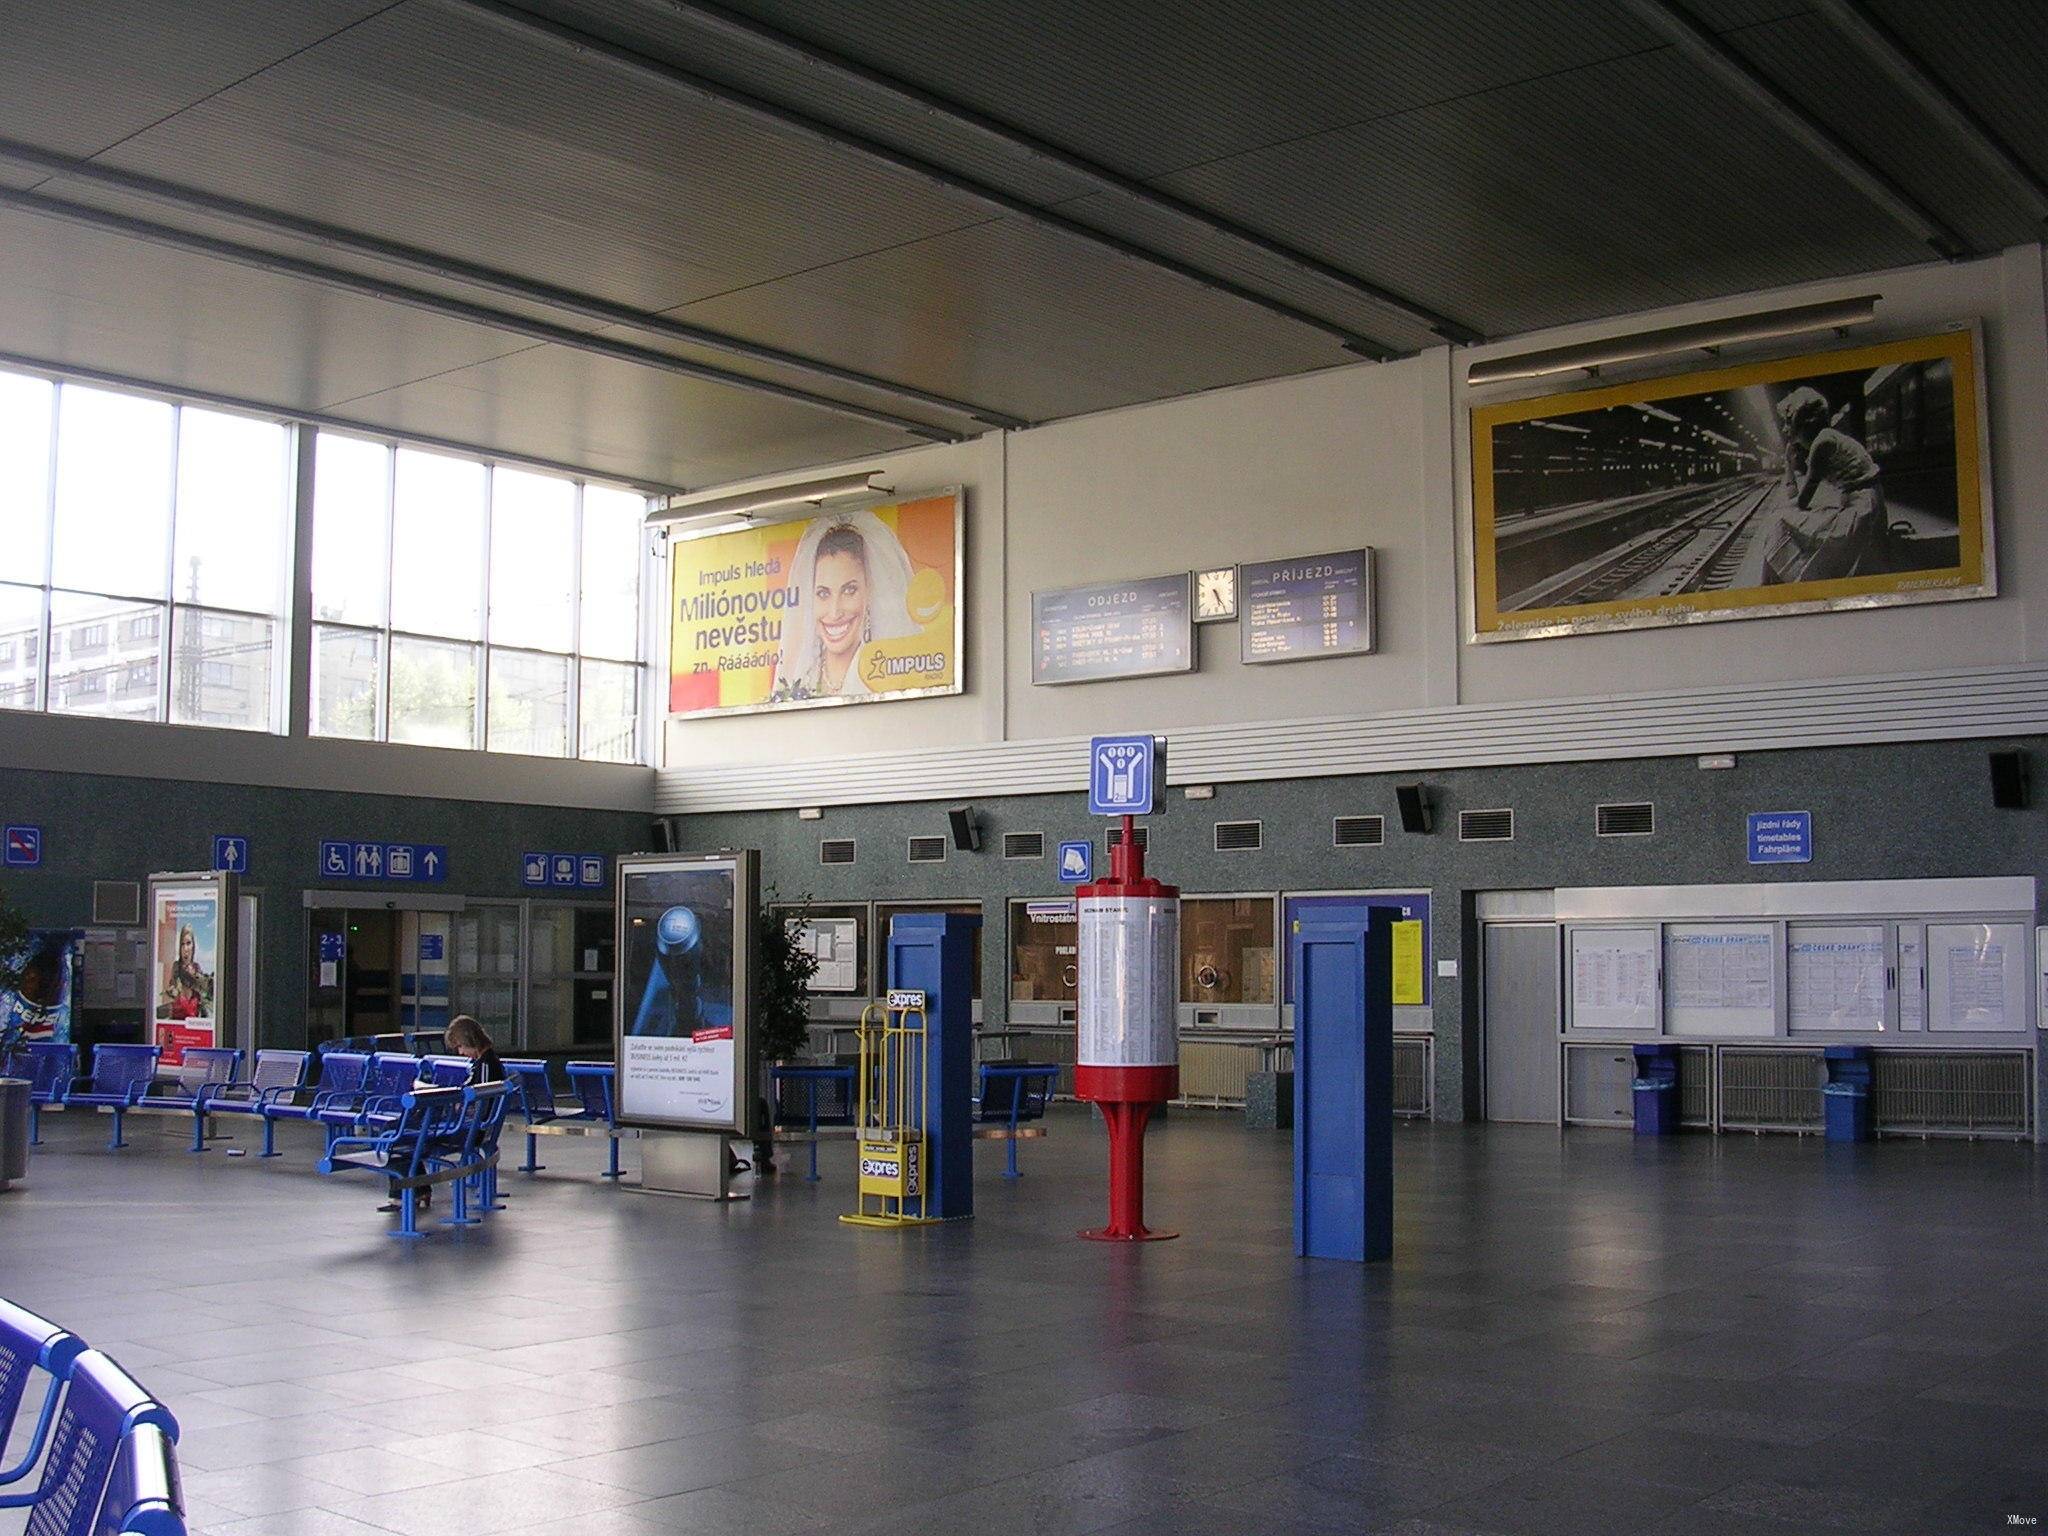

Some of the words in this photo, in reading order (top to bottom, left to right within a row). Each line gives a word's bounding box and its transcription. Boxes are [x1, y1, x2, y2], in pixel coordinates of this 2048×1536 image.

[699, 564, 741, 587] Impuls
[745, 557, 781, 578] hledá
[680, 585, 800, 623] Miliónovou
[1088, 591, 1138, 607] ODJEZD
[696, 615, 782, 651] nevěstu
[886, 652, 945, 676] IMPULS
[1757, 832, 1802, 842] timetables
[1031, 914, 1077, 924] Vnitrostátn
[889, 993, 923, 1007] expres
[862, 1159, 900, 1177] expres
